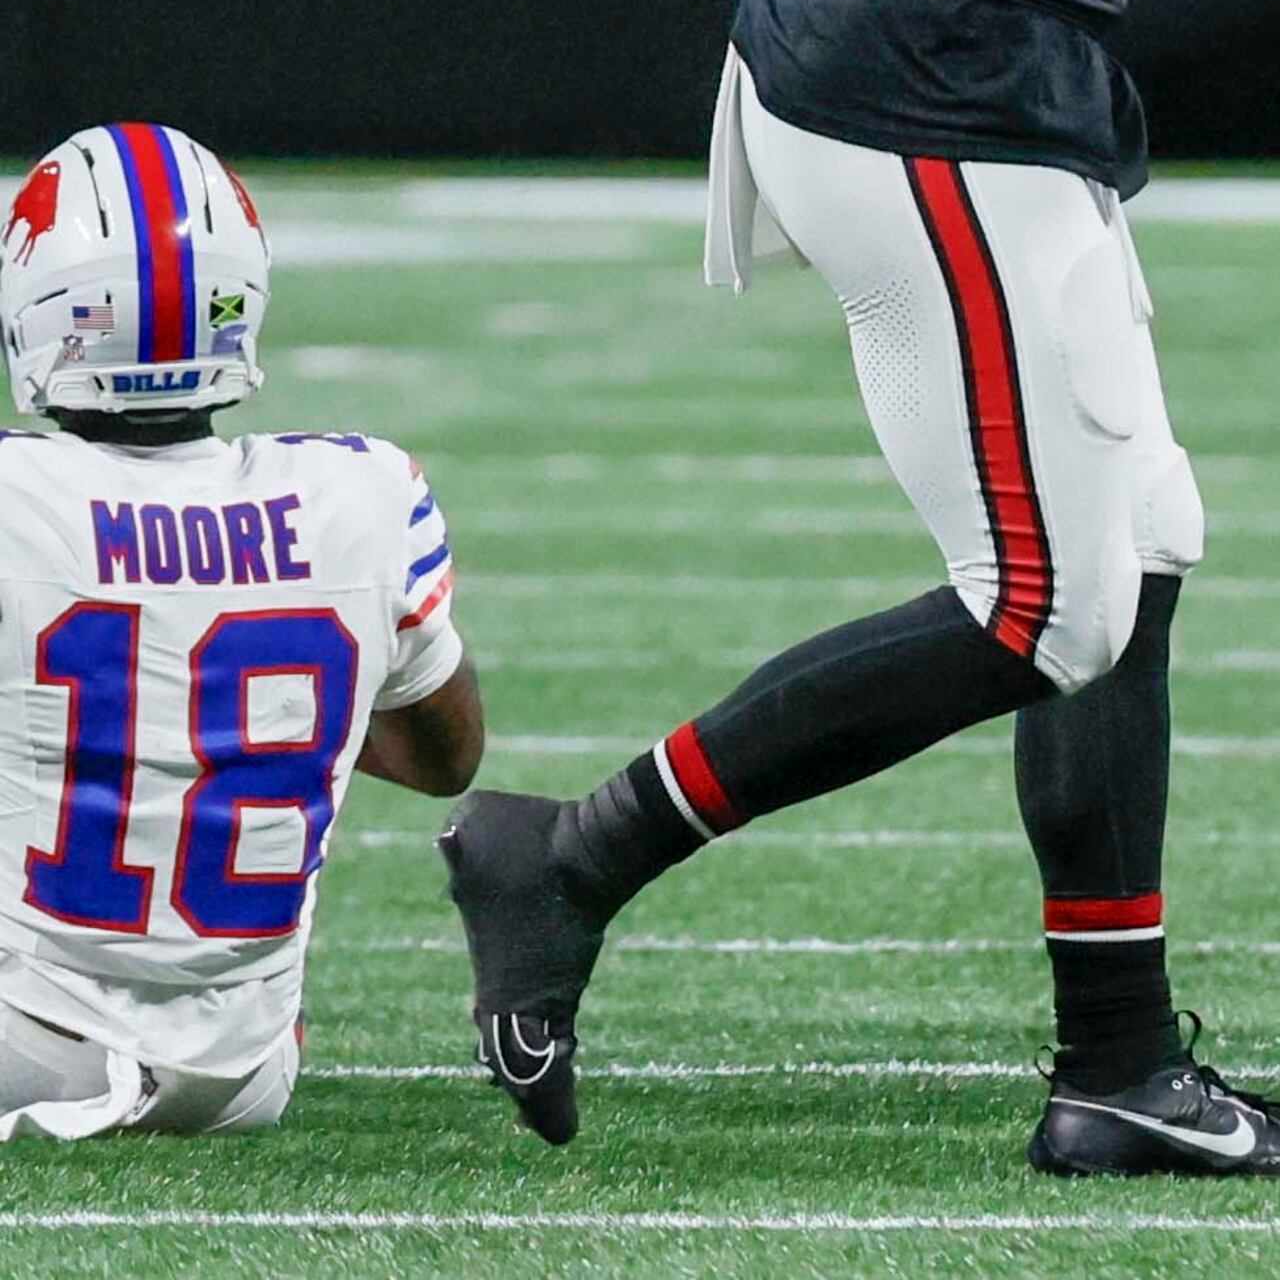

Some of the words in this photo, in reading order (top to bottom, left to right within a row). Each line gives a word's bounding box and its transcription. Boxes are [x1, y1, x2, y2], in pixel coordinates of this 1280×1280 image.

[111, 370, 203, 393] BILLS
[90, 494, 311, 585] MOORE
[22, 601, 358, 937] 18
